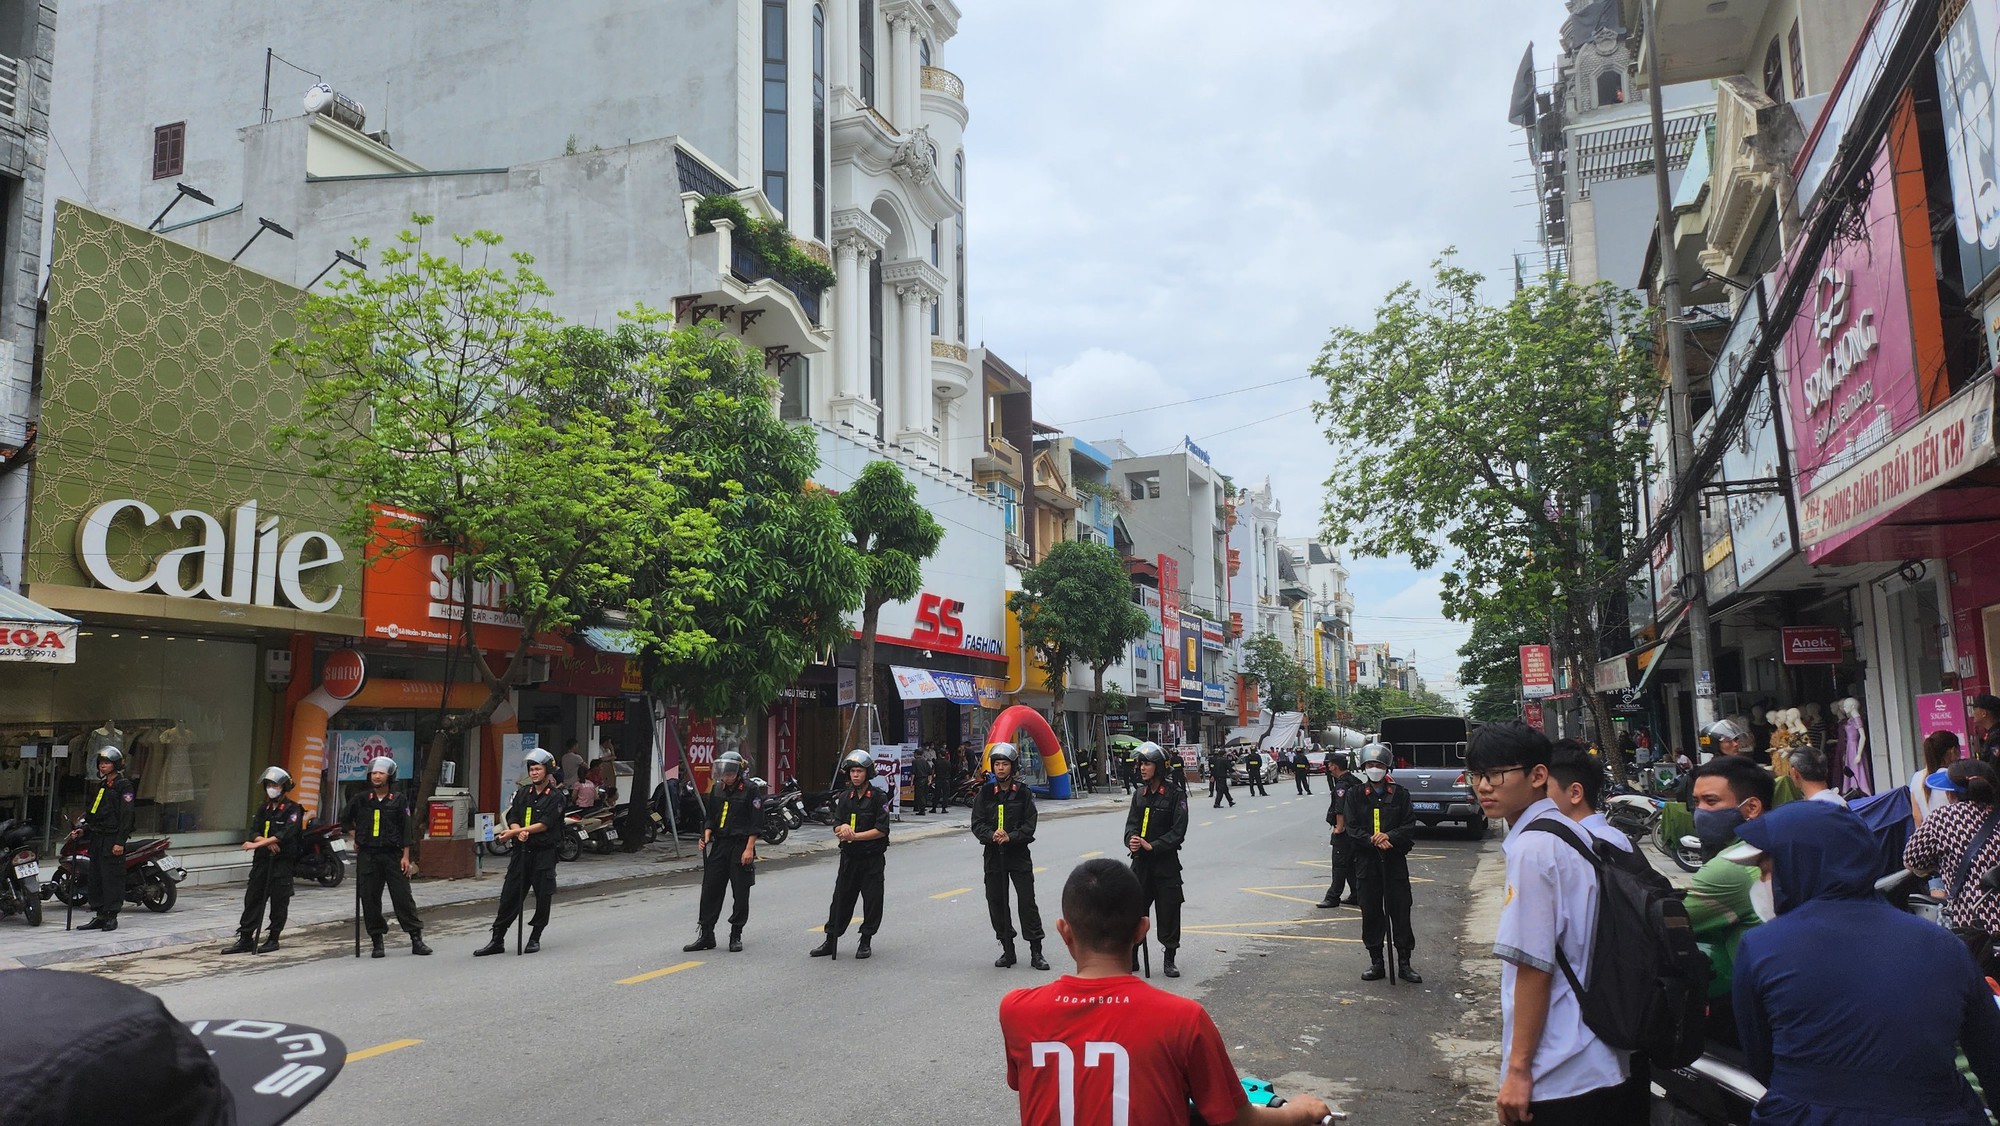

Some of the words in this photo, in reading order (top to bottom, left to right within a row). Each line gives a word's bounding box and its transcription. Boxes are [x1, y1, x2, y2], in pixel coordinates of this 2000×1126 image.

[1822, 486, 1851, 531] PHÒNG
[1852, 473, 1879, 515] RĂNG
[1912, 426, 1940, 486] TIẾN
[440, 607, 487, 627] HOMEEAR
[965, 633, 1003, 655] FASHION
[363, 744, 393, 765] 30%
[689, 744, 715, 764] 99K
[1031, 1041, 1129, 1126] 77
